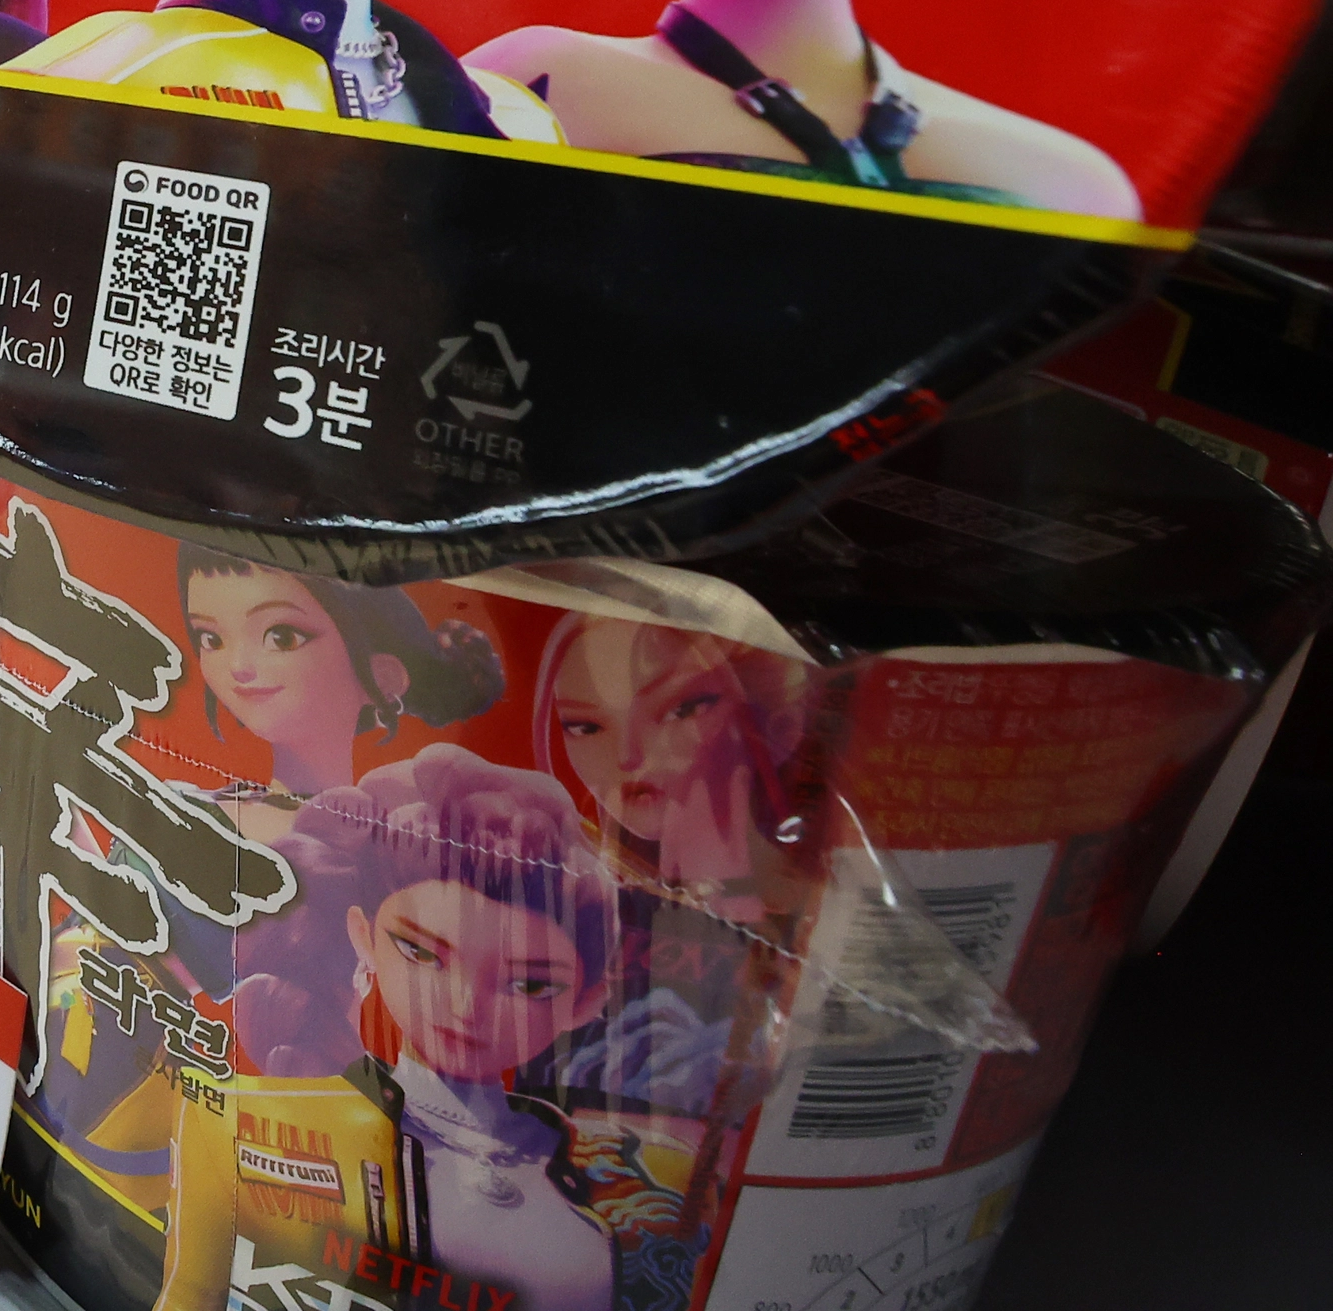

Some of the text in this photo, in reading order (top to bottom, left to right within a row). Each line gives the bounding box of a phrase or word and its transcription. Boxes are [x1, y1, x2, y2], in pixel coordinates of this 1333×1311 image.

[154, 174, 260, 212] FOOD QR
[52, 290, 73, 328] g
[98, 330, 234, 385] 다양한 정보는
[271, 326, 387, 380] 조리시간
[108, 362, 213, 409] QR로 확인
[263, 365, 374, 451] 3분
[414, 418, 524, 463] OTHER
[77, 944, 232, 1080] 라면
